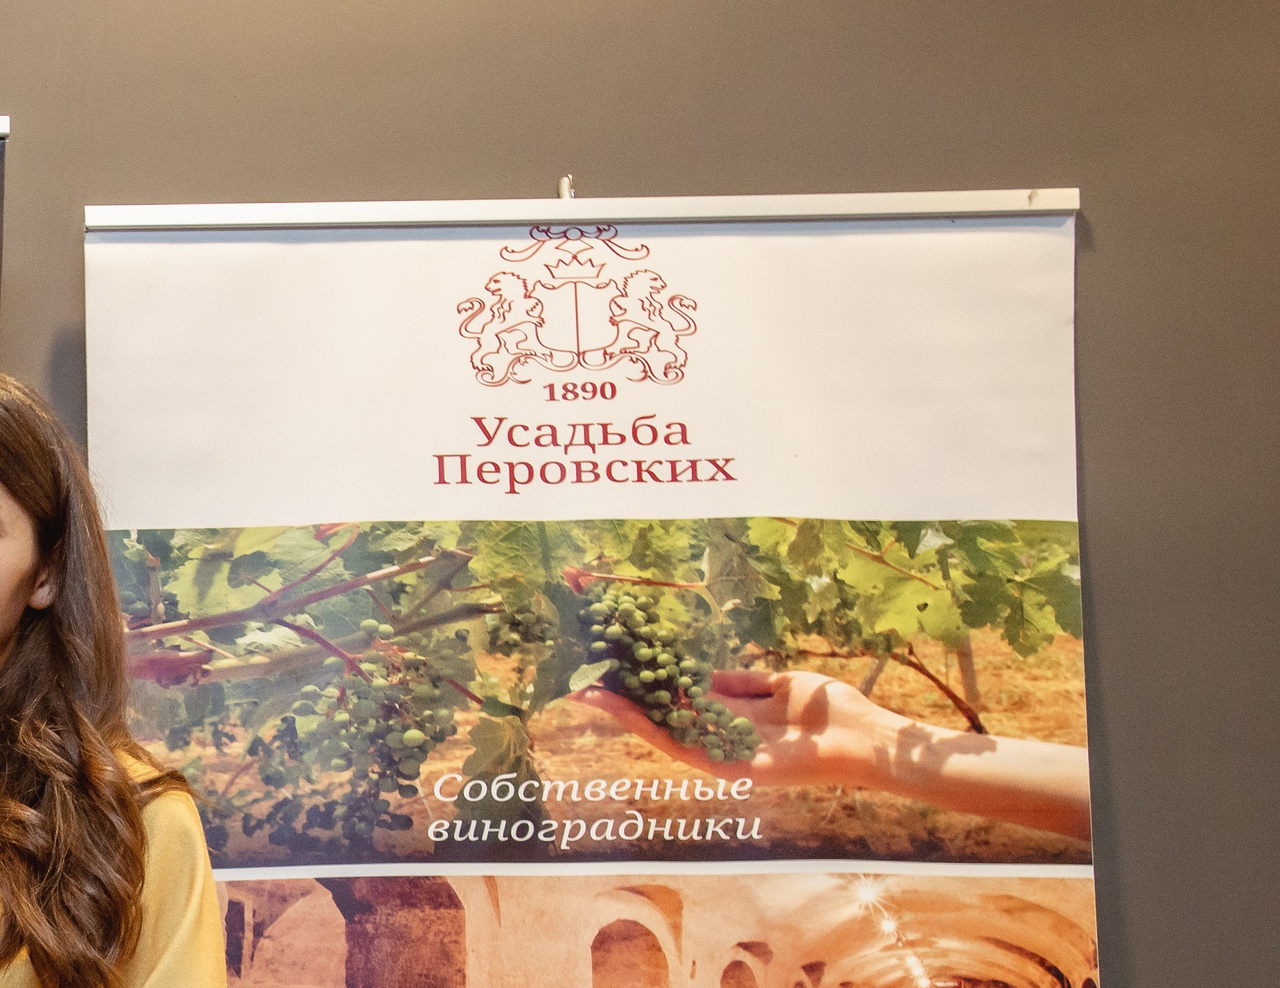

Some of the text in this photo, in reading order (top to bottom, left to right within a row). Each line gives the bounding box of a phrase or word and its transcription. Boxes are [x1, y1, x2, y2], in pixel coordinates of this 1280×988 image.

[542, 382, 617, 402] 1890
[470, 414, 692, 455] Усадьба
[432, 453, 738, 495] Перовских
[433, 772, 753, 802] Собственные
[427, 810, 763, 850] виноградники
